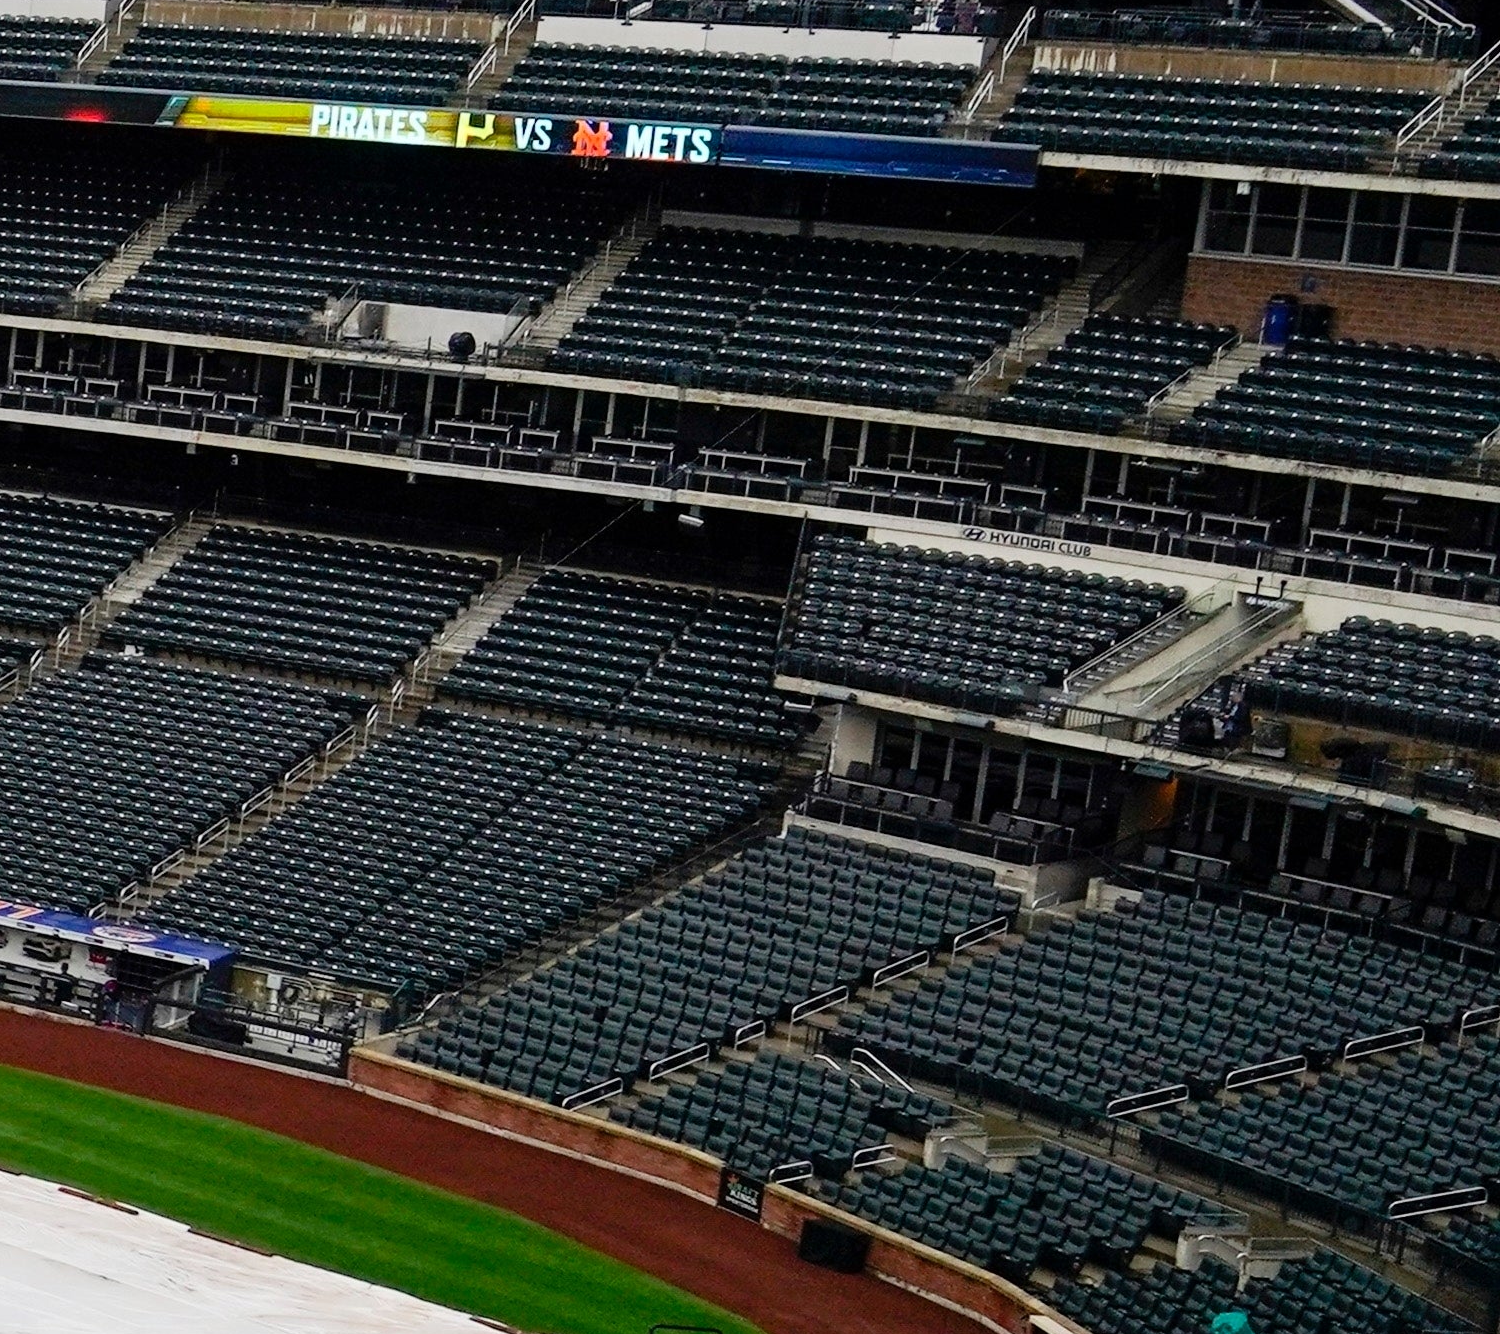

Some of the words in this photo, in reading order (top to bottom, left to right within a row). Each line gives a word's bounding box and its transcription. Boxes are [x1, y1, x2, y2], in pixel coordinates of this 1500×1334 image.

[311, 104, 429, 142] PIRATES
[514, 118, 553, 152] VS
[625, 124, 712, 165] METS
[990, 531, 1056, 551] HYUNDAI
[1059, 541, 1092, 557] CLUB
